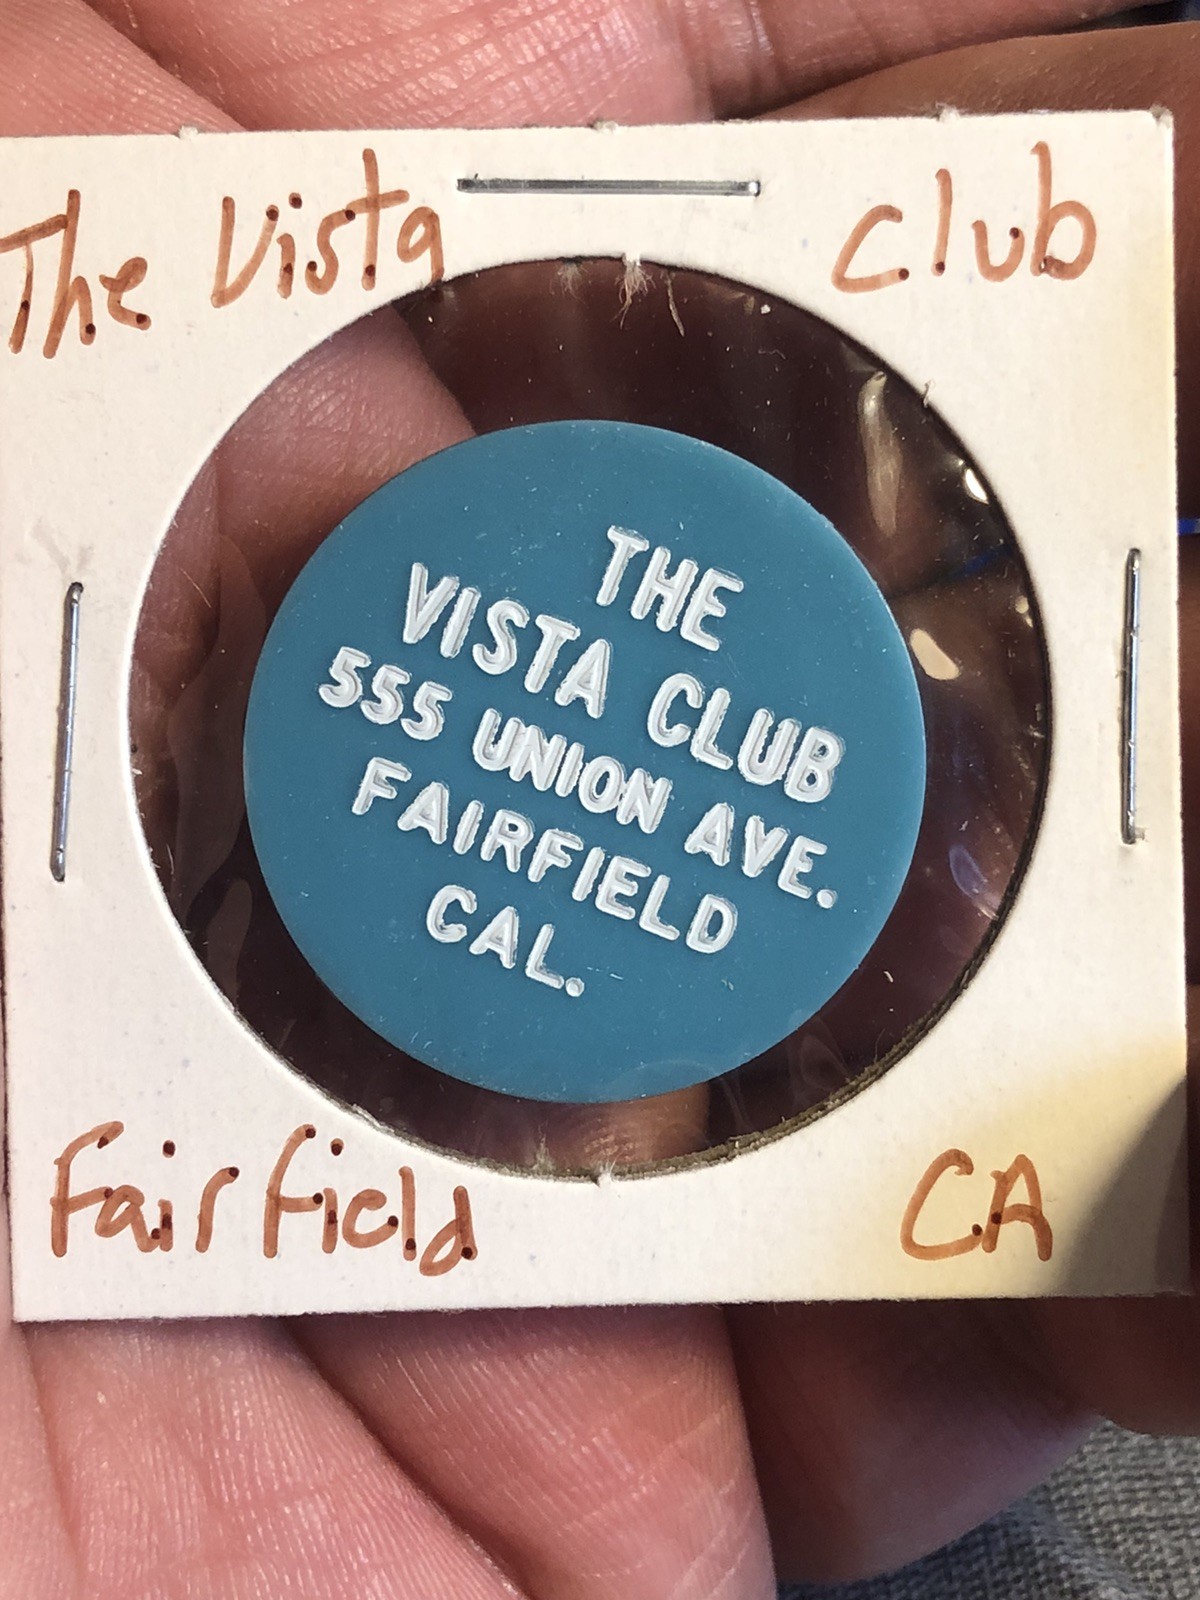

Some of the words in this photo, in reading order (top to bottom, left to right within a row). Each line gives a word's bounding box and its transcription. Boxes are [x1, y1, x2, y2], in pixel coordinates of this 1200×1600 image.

[0, 189, 152, 359] The
[210, 148, 446, 308] Vista
[402, 561, 612, 719] VISTA
[646, 672, 845, 804] CLUB
[595, 524, 745, 652] THE
[318, 645, 453, 741] 555
[472, 707, 673, 834] UNION
[684, 802, 837, 909] AVE.
[351, 756, 739, 954] FAIRFIELD
[425, 884, 586, 998] CAL.
[900, 1148, 1053, 1262] CA
